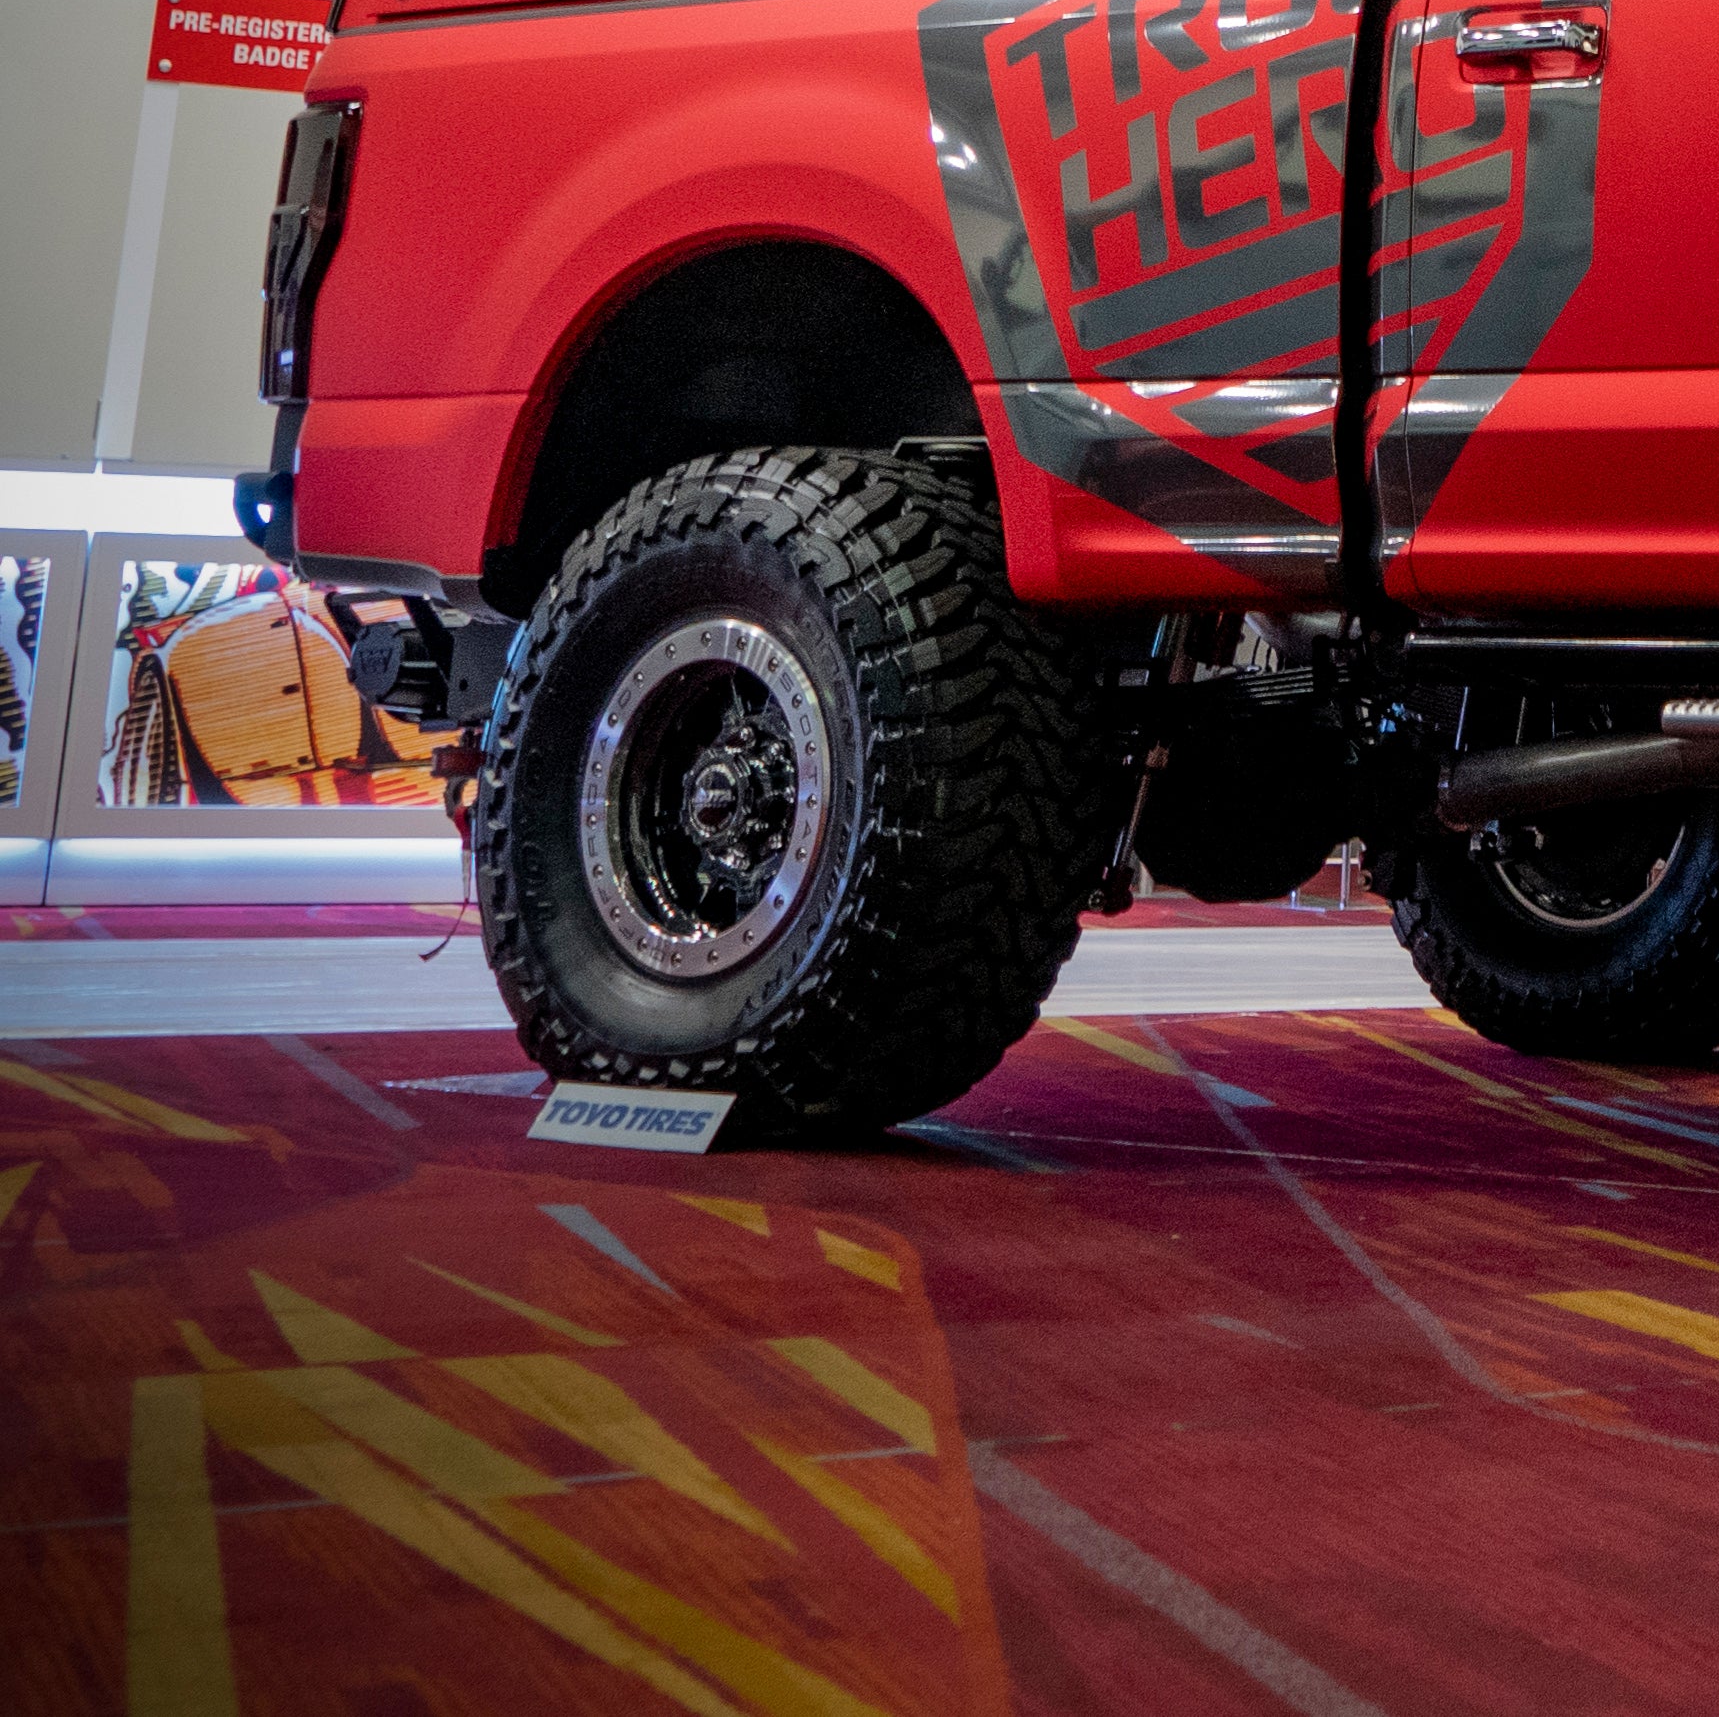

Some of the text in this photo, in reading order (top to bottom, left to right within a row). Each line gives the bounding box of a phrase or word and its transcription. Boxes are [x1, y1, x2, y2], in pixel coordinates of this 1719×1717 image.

[233, 43, 309, 70] BADGE
[1059, 8, 1513, 293] HERO
[544, 1098, 714, 1136] TOYO TIRES
